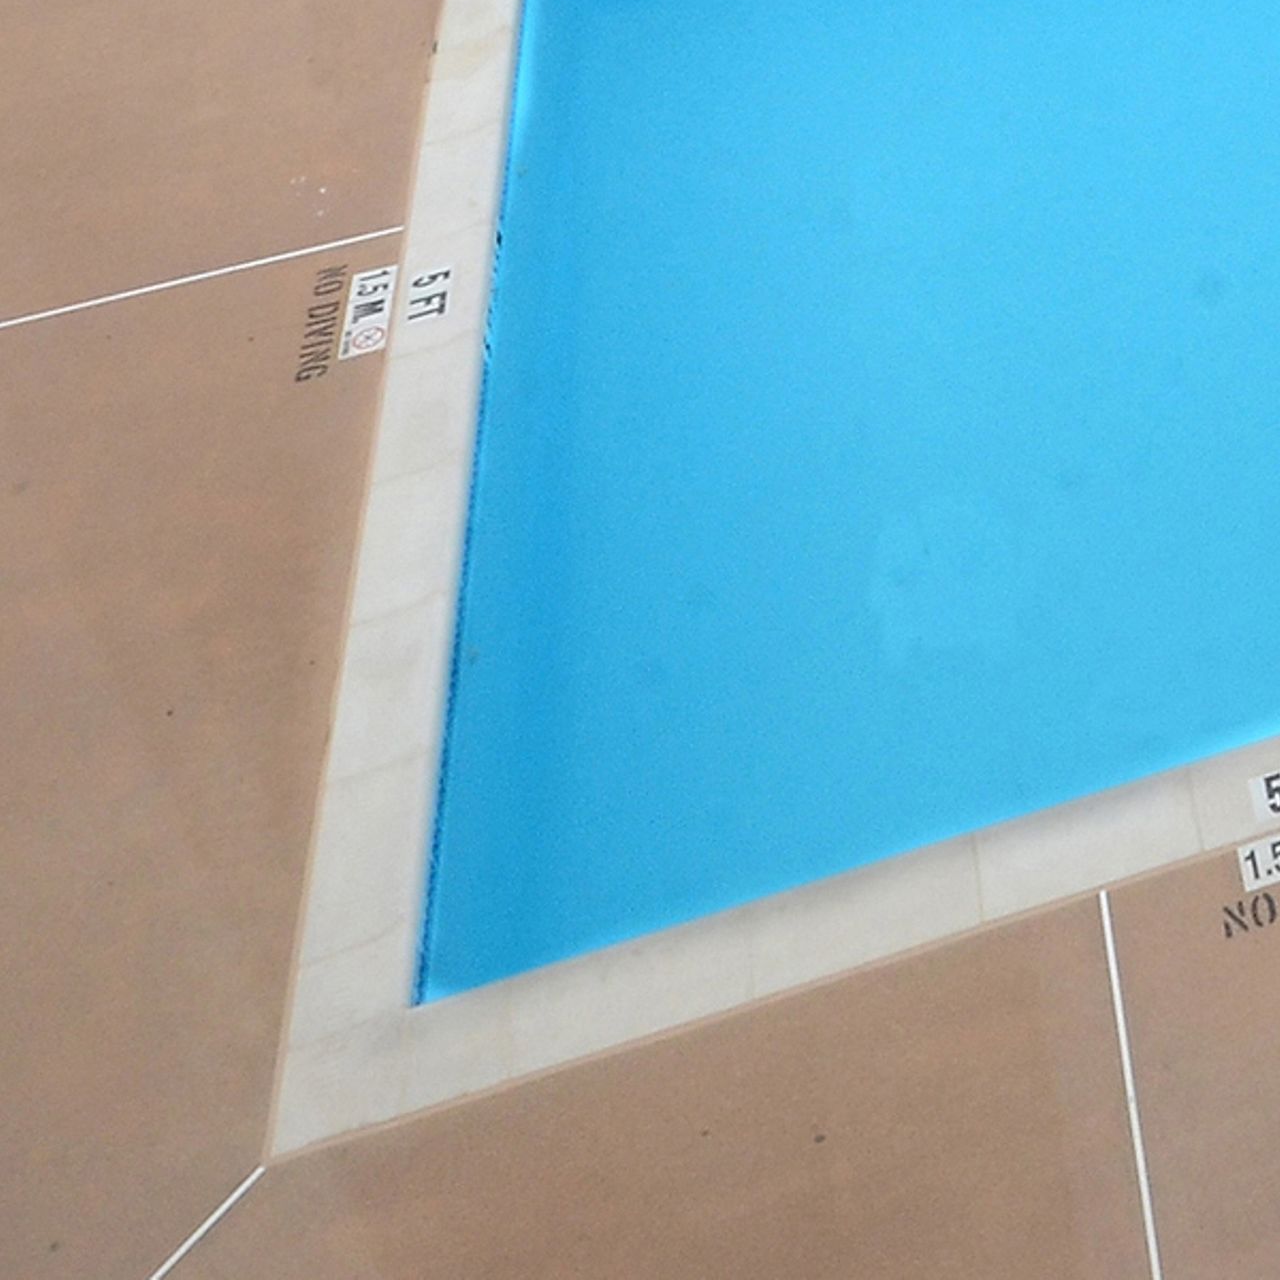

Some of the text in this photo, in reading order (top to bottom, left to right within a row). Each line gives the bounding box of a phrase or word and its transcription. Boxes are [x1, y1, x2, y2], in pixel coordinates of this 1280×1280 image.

[407, 269, 451, 322] 5 FT
[294, 264, 348, 384] NO DIVING
[1222, 891, 1278, 939] NO
